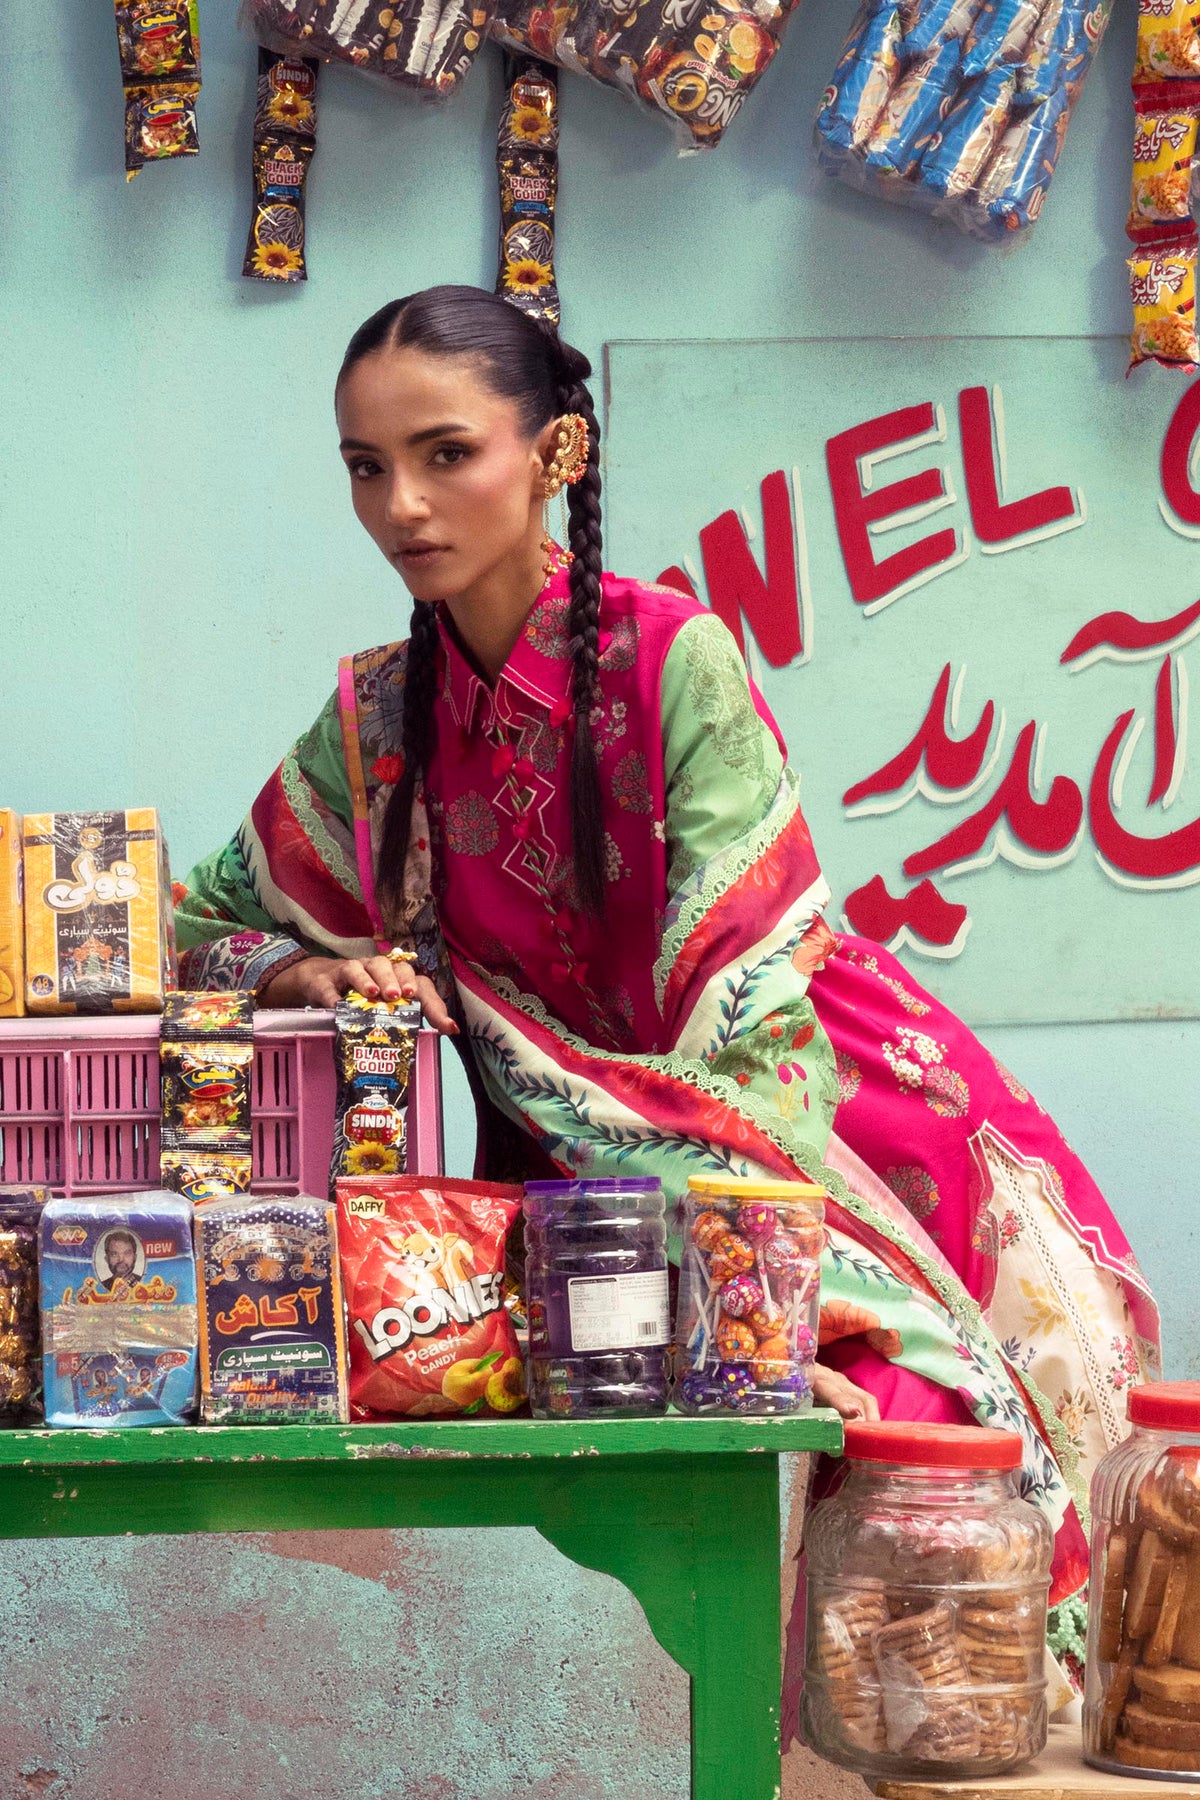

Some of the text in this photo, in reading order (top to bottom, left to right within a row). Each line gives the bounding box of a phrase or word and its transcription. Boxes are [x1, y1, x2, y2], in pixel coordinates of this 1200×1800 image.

[265, 160, 304, 173] BLACK
[267, 173, 300, 186] GOLD
[511, 177, 549, 190] BLACK
[514, 189, 546, 201] GOLD
[353, 1047, 401, 1062] BLACK
[357, 1060, 396, 1074] GOLD
[351, 1114, 398, 1130] SINDH
[351, 1200, 384, 1214] DAFFY
[146, 1242, 173, 1255] new
[215, 1286, 322, 1336] آکاش
[353, 1271, 504, 1363] LOONIES
[403, 1333, 463, 1368] Peach
[420, 1350, 457, 1376] CANDY
